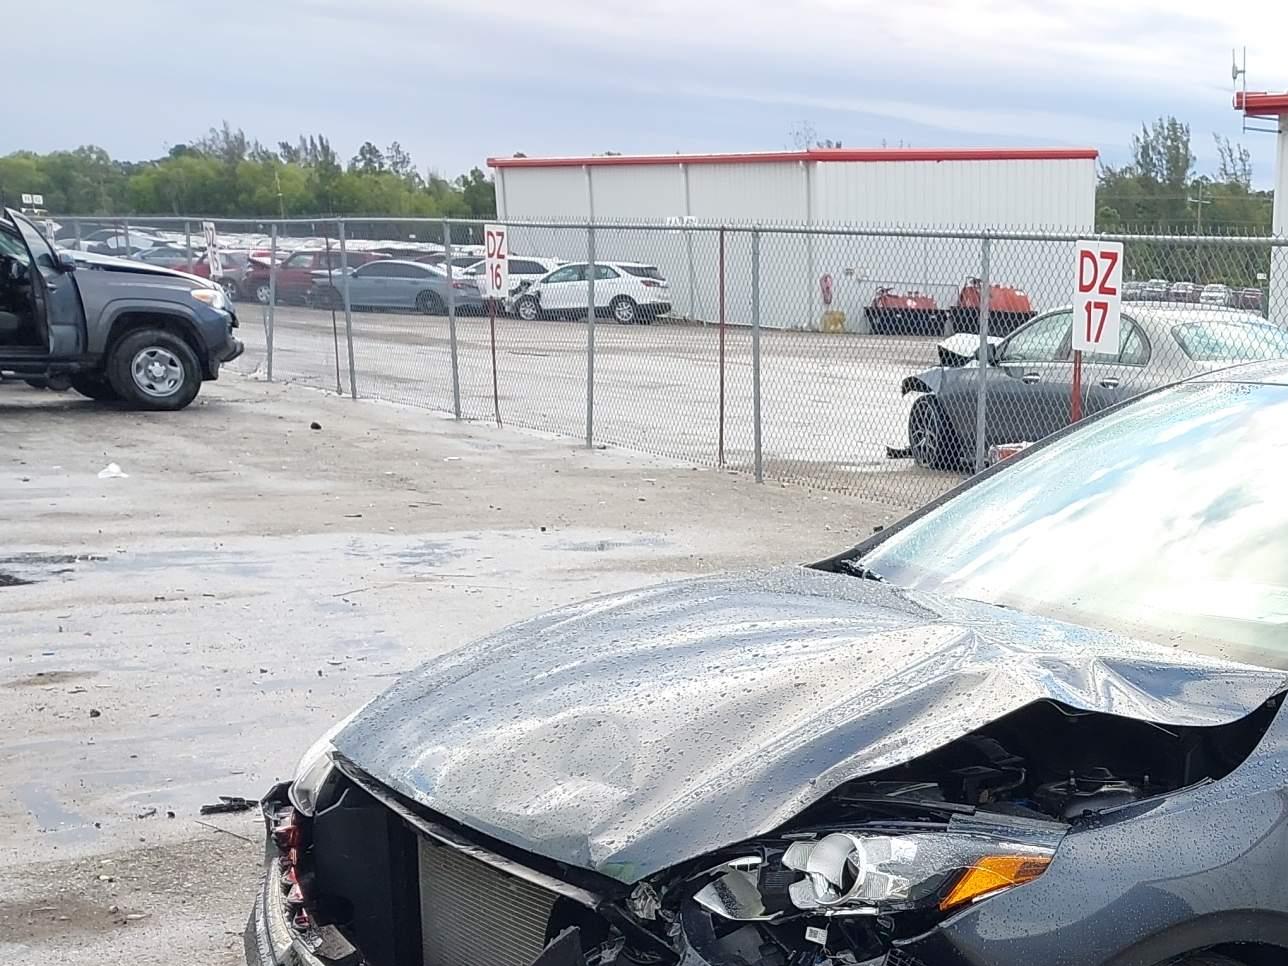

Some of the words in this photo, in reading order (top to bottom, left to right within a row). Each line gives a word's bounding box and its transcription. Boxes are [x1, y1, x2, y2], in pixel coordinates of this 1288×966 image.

[486, 230, 506, 260] DZ
[490, 263, 503, 291] 16
[1078, 249, 1119, 296] DZ
[1084, 300, 1109, 344] 17
